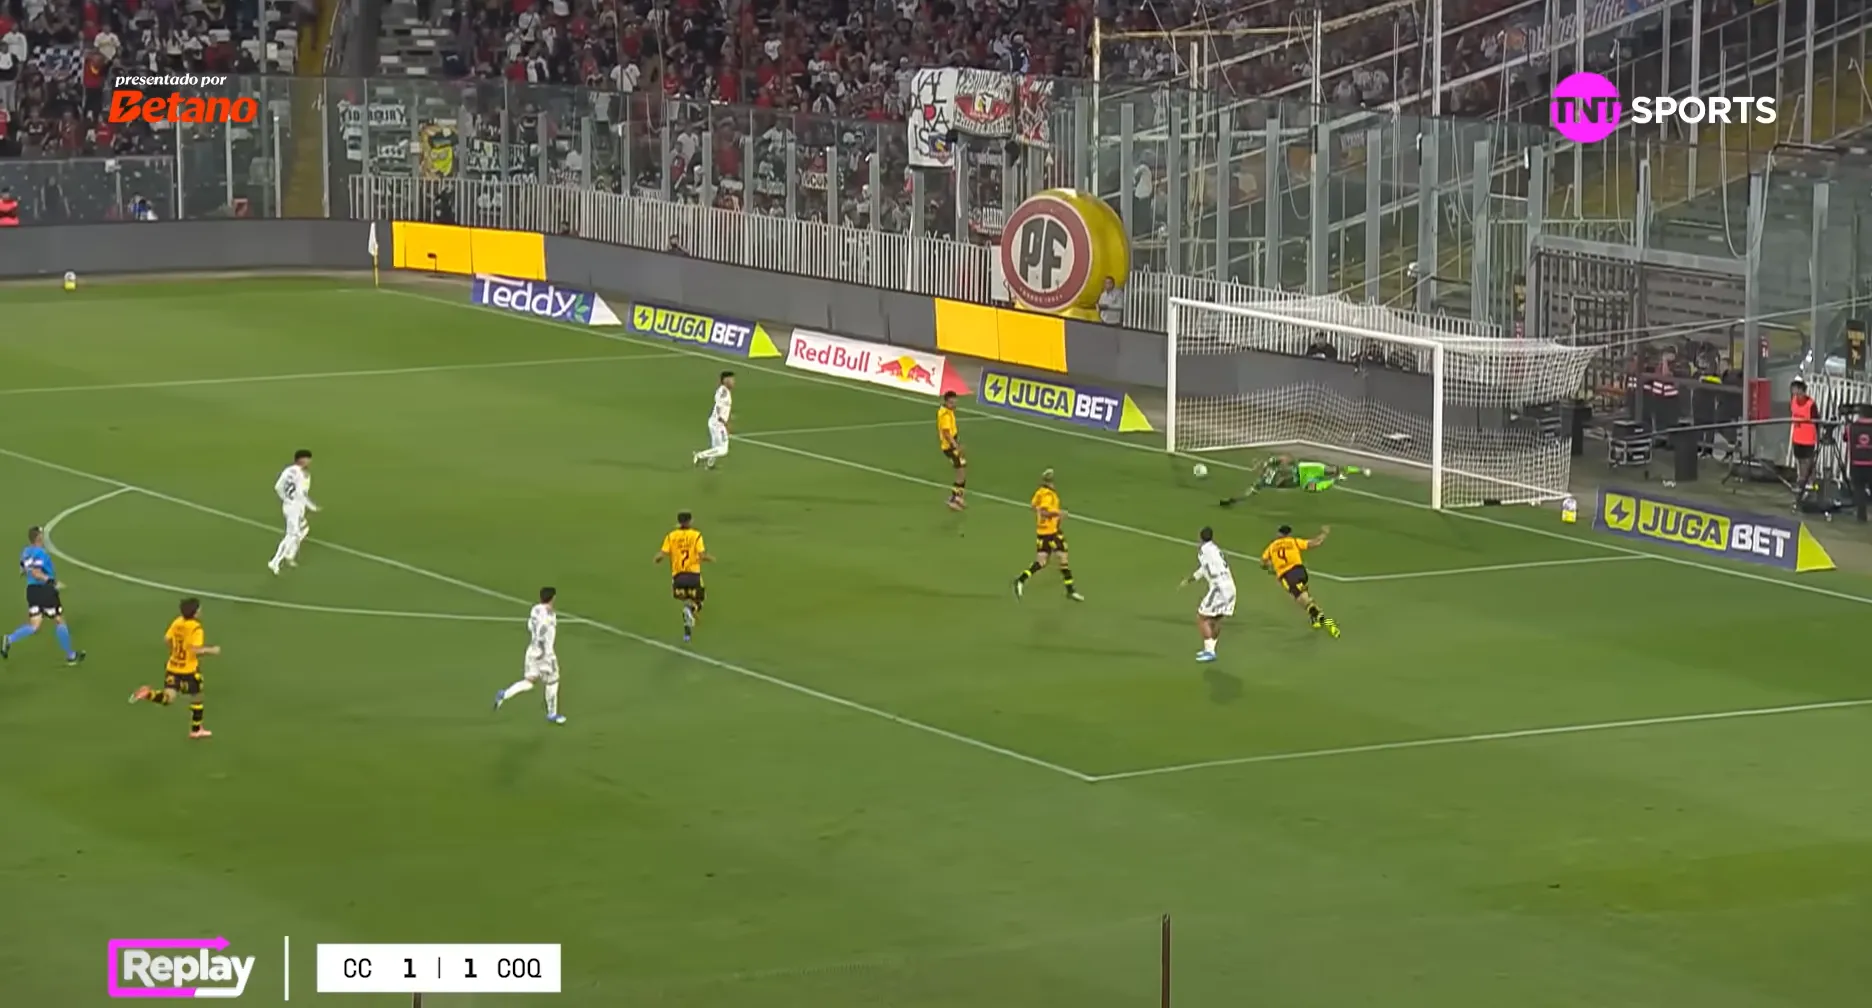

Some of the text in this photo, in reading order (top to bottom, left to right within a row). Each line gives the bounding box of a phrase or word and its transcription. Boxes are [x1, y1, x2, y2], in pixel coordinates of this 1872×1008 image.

[1019, 216, 1069, 290] PF
[475, 272, 577, 318] Teddy
[794, 338, 871, 373] Red Bull
